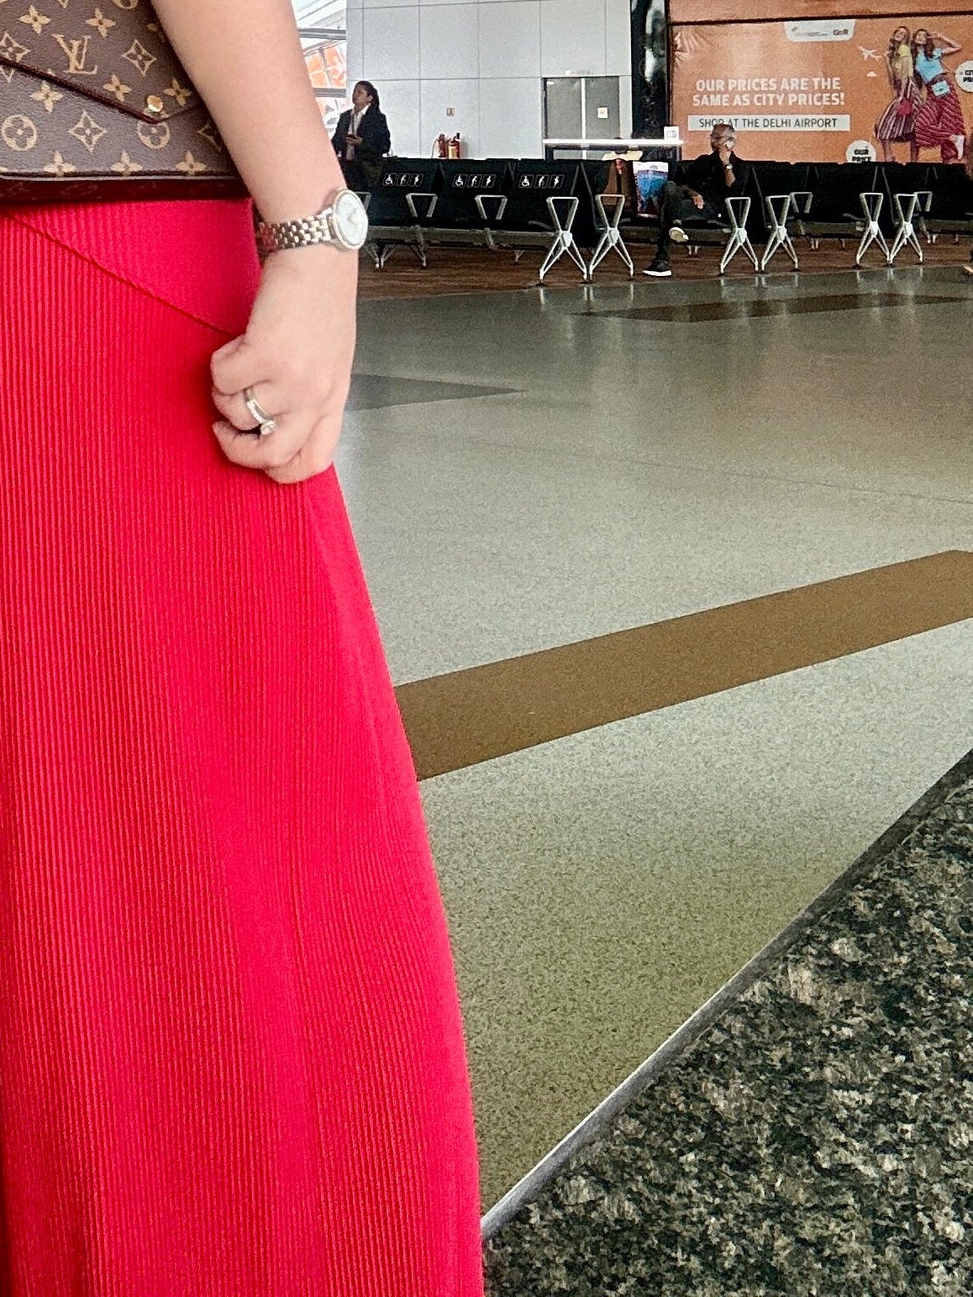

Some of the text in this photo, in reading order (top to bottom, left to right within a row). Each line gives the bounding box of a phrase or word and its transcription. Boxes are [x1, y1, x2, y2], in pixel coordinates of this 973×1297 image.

[696, 77, 841, 91] OUR PRICES ARE THE
[692, 92, 845, 106] SAME AS CITY PRICES!
[728, 118, 739, 128] AT
[742, 118, 760, 128] THE
[763, 118, 791, 128] DELHI
[795, 118, 838, 128] AIRPORT
